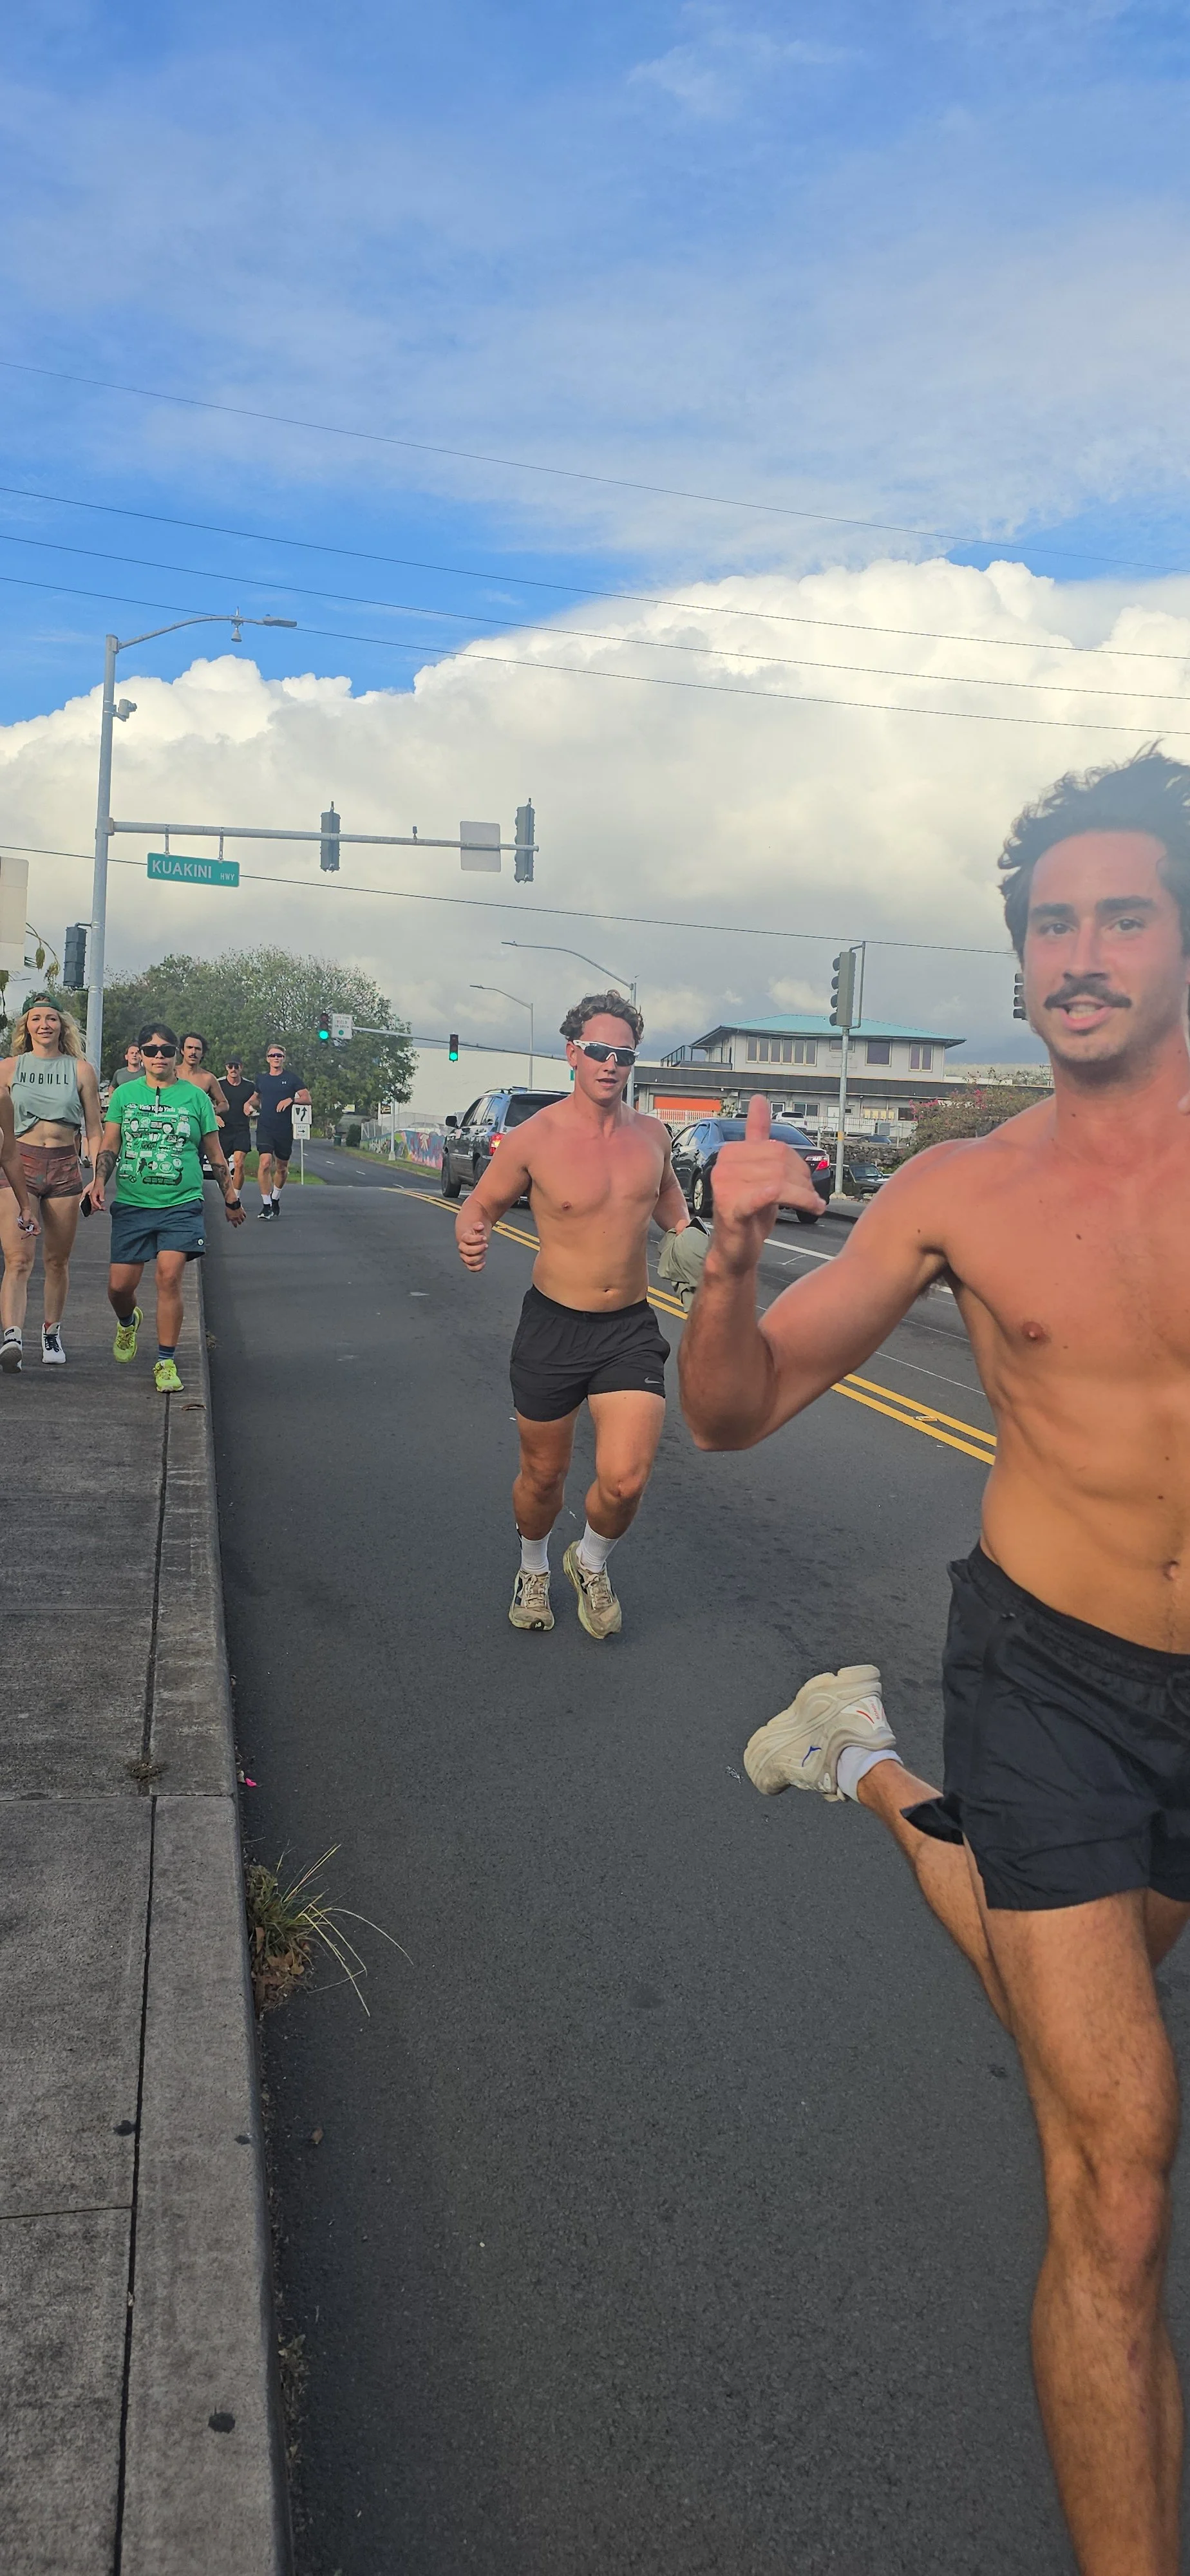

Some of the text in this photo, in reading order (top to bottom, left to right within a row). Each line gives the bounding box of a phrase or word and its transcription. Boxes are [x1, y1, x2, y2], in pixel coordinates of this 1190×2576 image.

[152, 860, 235, 881] KUAKINI HWY
[20, 1072, 69, 1085] NOBULL
